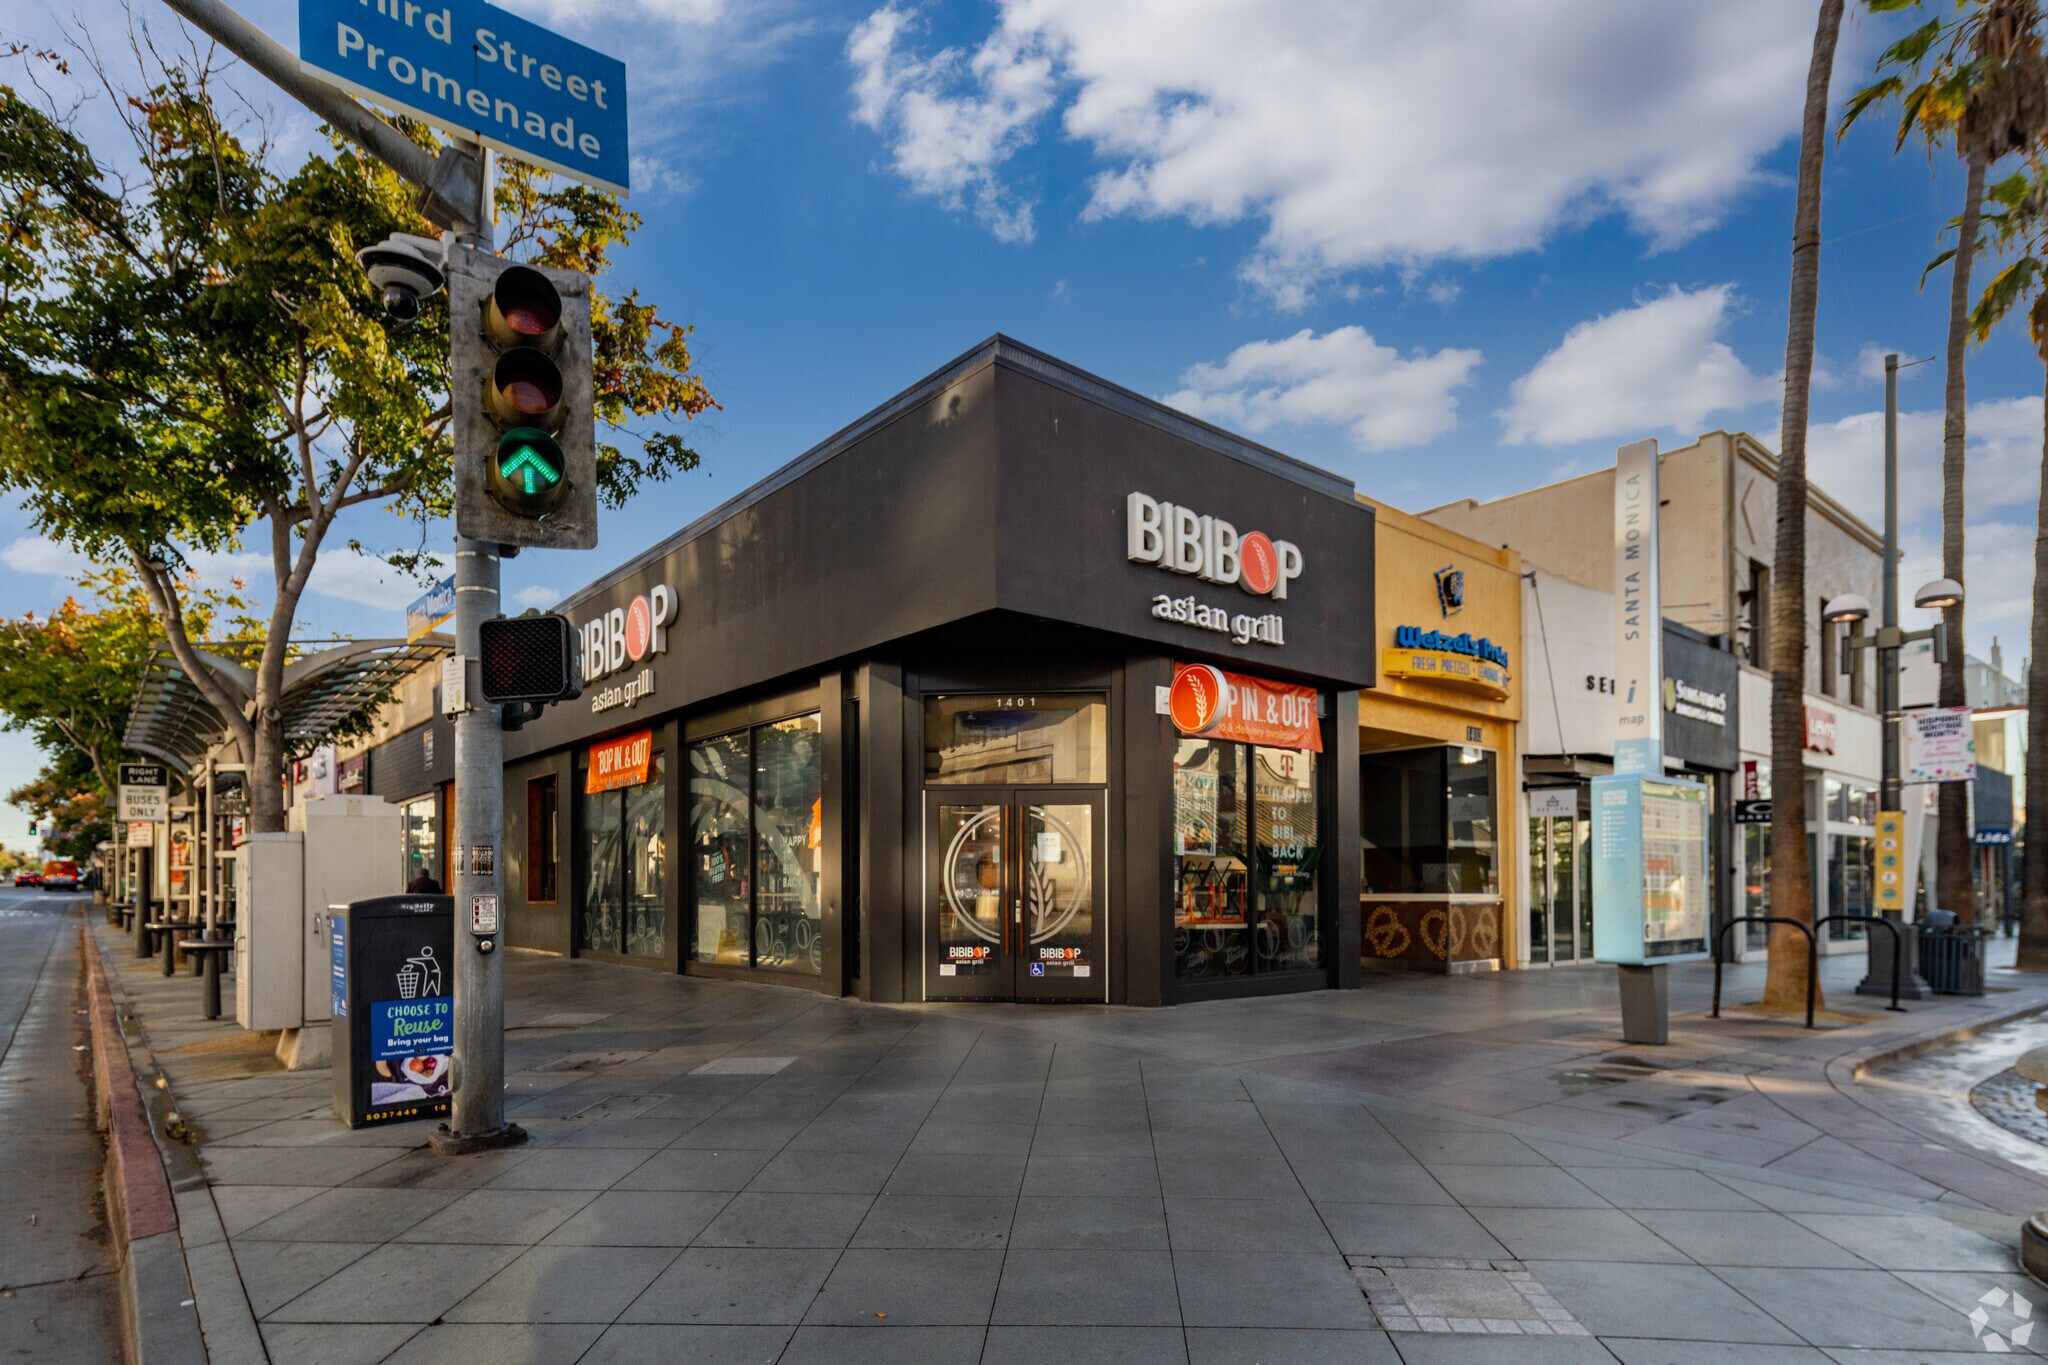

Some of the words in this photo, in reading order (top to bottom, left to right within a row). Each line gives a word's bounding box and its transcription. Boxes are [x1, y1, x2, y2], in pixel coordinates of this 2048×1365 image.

[358, 0, 452, 44] ird
[474, 28, 608, 110] Street
[337, 21, 601, 159] Promenade
[1625, 474, 1641, 560] MONICA
[1127, 491, 1303, 600] BIBIBOP
[1625, 571, 1640, 641] SANTA
[1152, 594, 1230, 632] asian
[1231, 614, 1285, 645] grill
[1411, 655, 1437, 671] FRESH
[1441, 658, 1471, 675] PRETZELS
[591, 687, 622, 713] asian
[624, 668, 655, 708] grill
[996, 697, 1035, 707] 1401
[1266, 693, 1279, 725] &
[1281, 693, 1311, 730] OUT
[1619, 713, 1645, 727] map
[631, 737, 649, 767] OUT
[128, 767, 159, 776] RIGHT
[129, 776, 158, 784] LANE
[125, 794, 160, 805] BUSES
[1272, 788, 1309, 803] HAPPY
[1180, 798, 1192, 809] Be
[129, 806, 156, 817] ONLY
[1271, 806, 1287, 820] TO
[1272, 825, 1294, 839] BIBI
[782, 834, 807, 847] HAPPY
[1272, 844, 1304, 859] BACK
[708, 863, 726, 877] GLUTEN
[782, 878, 802, 888] BACK
[949, 946, 990, 958] BIBIBOP
[1040, 947, 1081, 959] BIBIBOP
[387, 1003, 431, 1019] CHOOSE
[434, 1002, 448, 1015] TO
[393, 1017, 444, 1037] Reuse
[387, 1038, 411, 1047] Bring
[413, 1037, 432, 1046] your
[433, 1034, 449, 1043] bag
